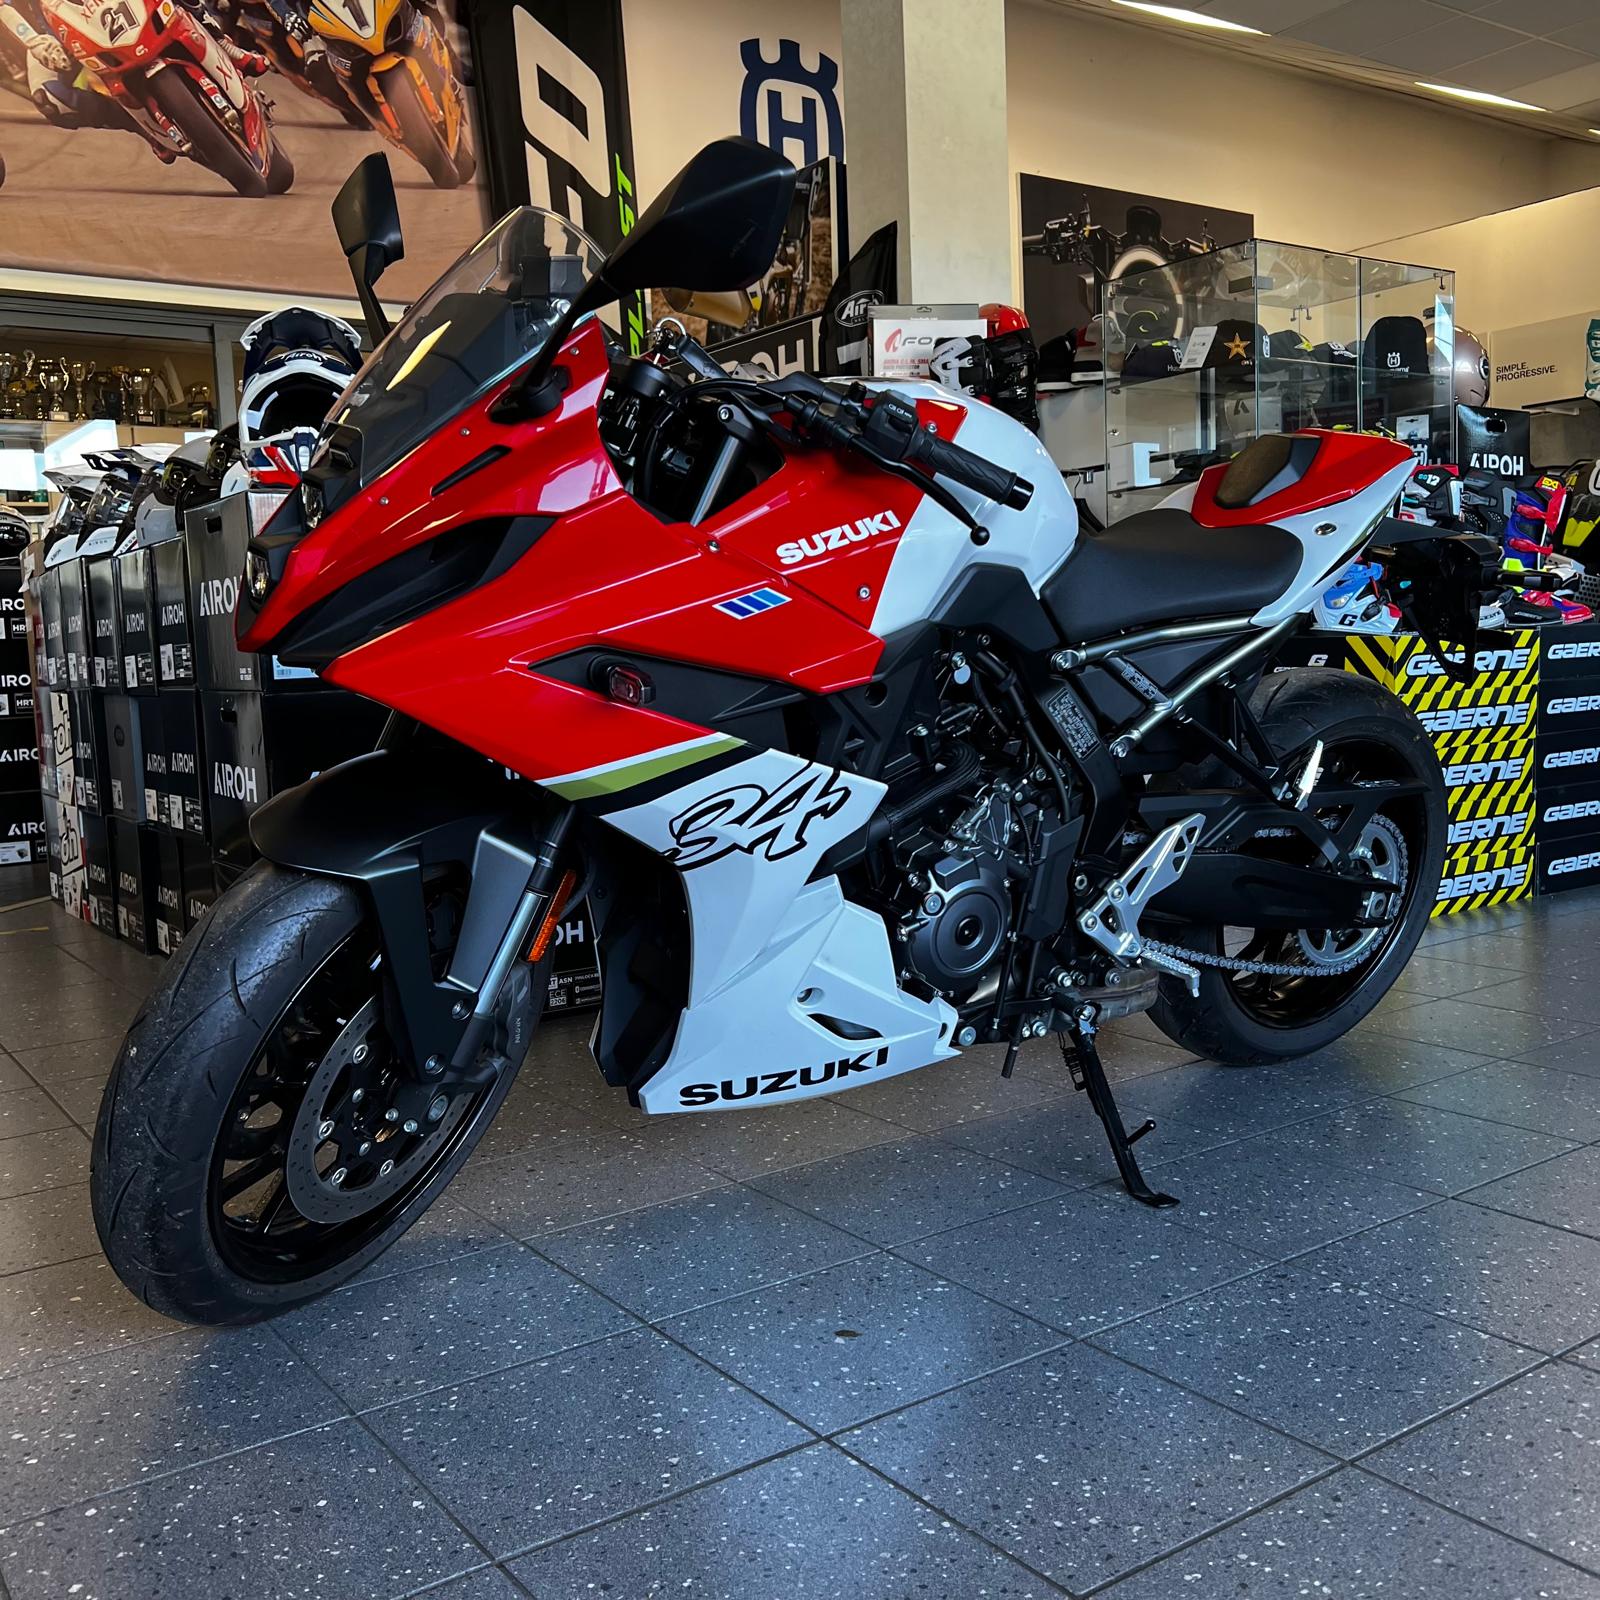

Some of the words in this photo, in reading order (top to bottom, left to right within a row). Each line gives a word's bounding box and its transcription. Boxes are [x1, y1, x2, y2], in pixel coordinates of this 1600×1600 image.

[101, 0, 140, 45] 21
[1496, 362, 1529, 375] SIMPLE.
[1496, 365, 1559, 383] PROGRESSIVE.
[776, 510, 901, 565] SUZUKI
[126, 613, 146, 633] AIROH
[162, 603, 185, 626] AIROH
[147, 753, 167, 775] AIROH
[171, 752, 195, 775] AIROH
[1443, 757, 1526, 787] ERNE
[214, 761, 258, 803] AIROH
[1447, 812, 1529, 844] ERNE
[119, 871, 138, 896] AIROH
[158, 885, 179, 911] AIROH
[679, 1046, 889, 1107] SUZUKI
